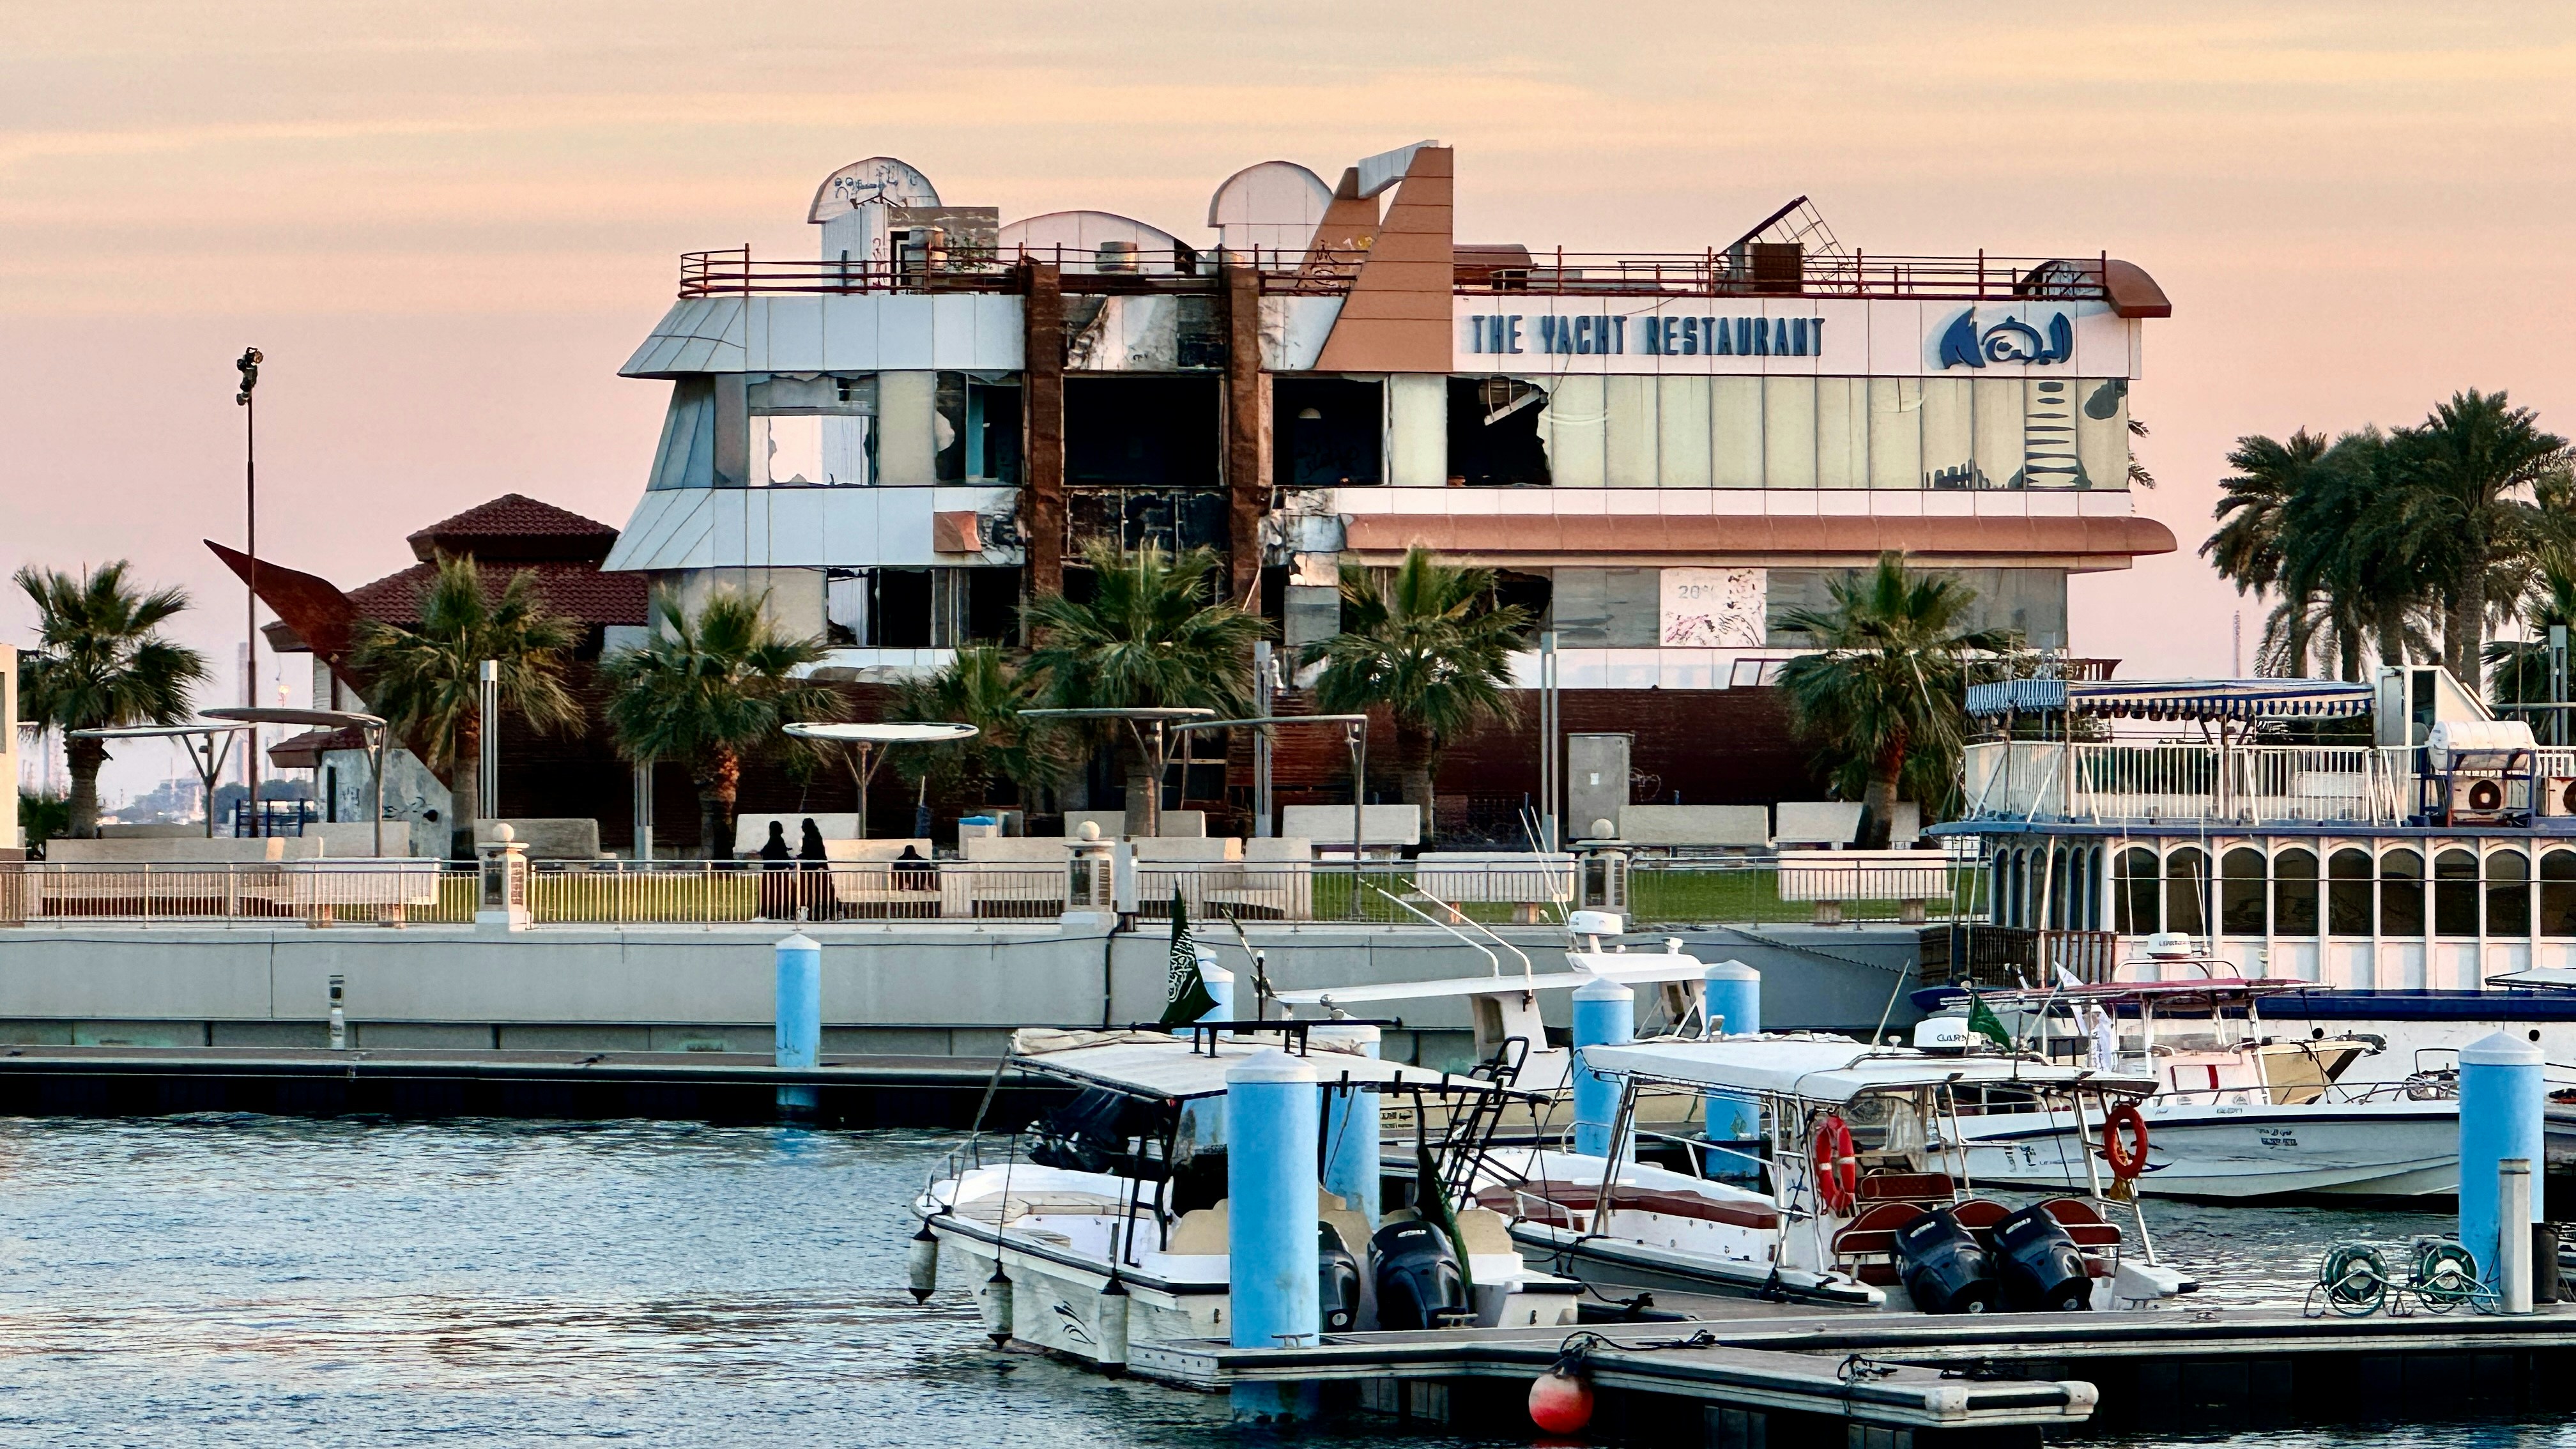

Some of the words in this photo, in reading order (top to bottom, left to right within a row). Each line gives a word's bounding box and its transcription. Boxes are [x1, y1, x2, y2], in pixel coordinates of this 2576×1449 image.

[1471, 314, 1524, 354] THE
[1542, 314, 1627, 355] YACHT
[1646, 316, 1825, 356] RESTAURANT
